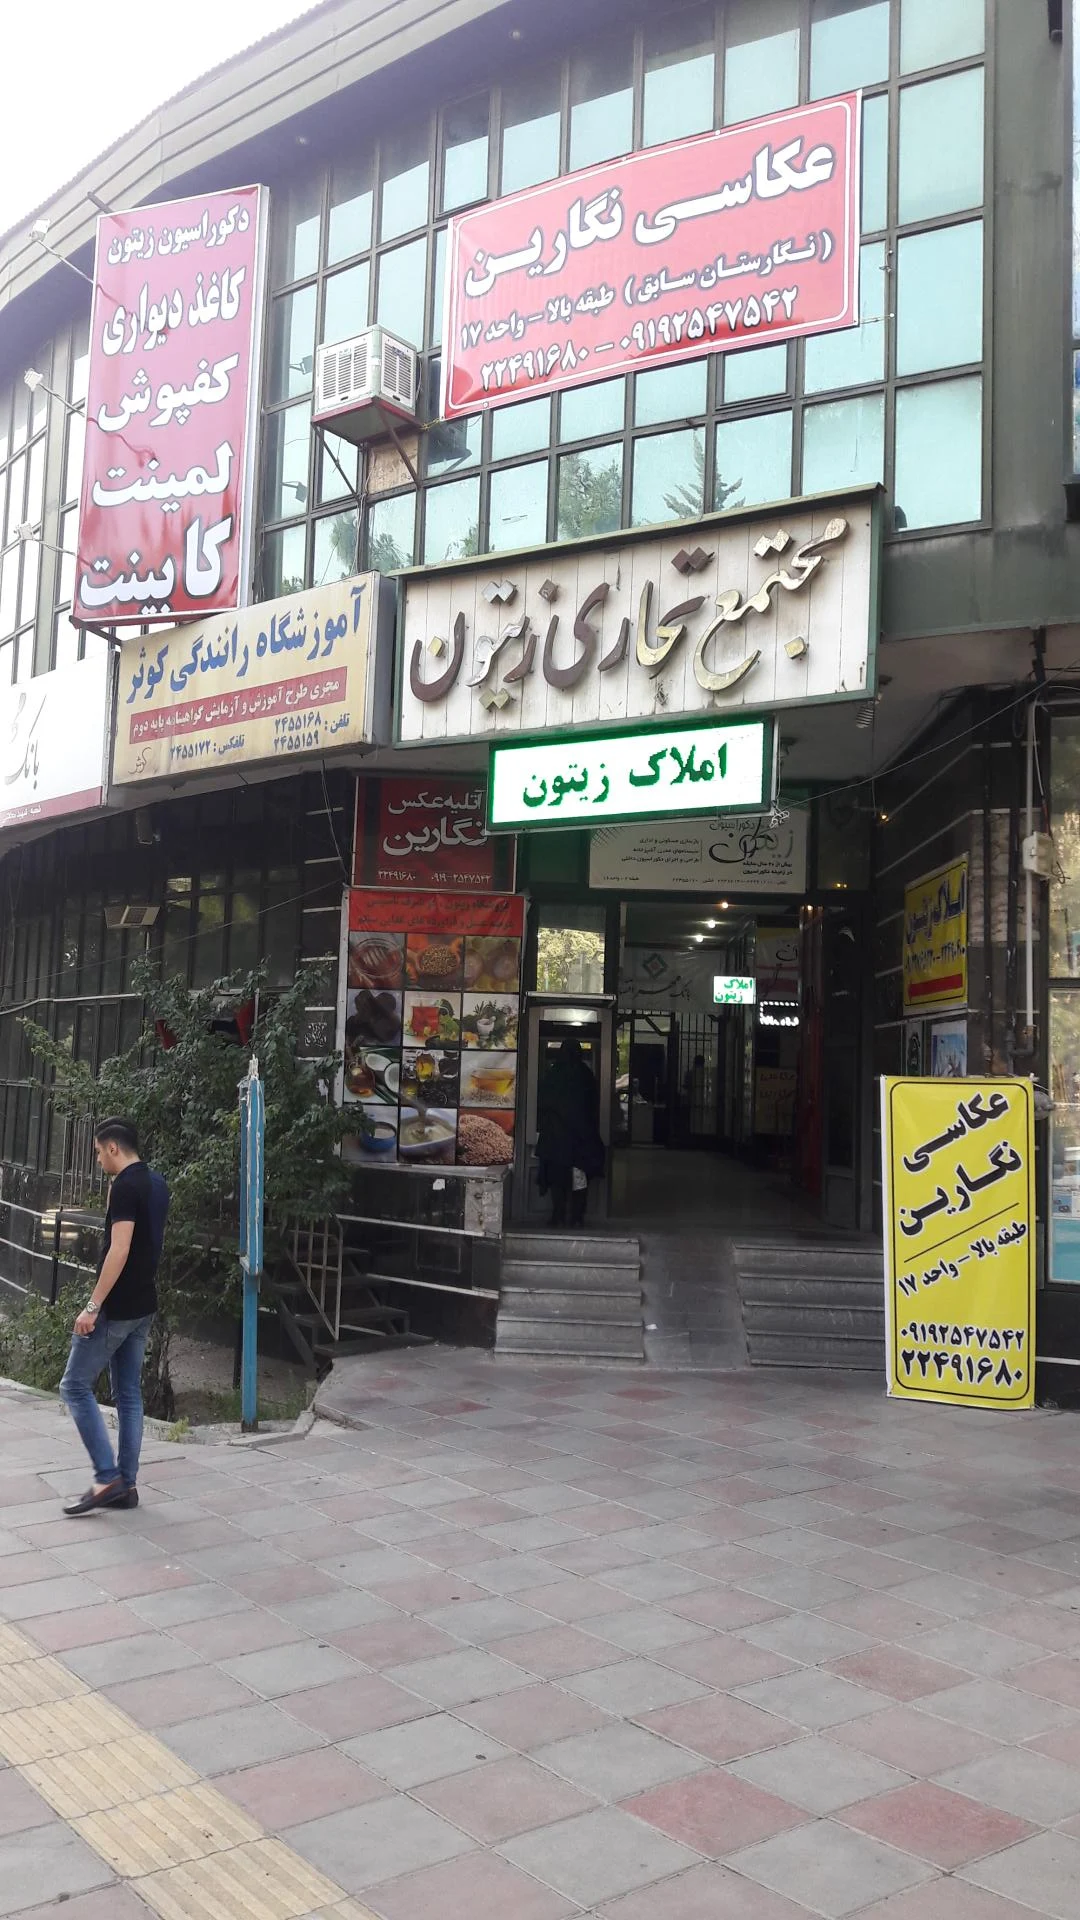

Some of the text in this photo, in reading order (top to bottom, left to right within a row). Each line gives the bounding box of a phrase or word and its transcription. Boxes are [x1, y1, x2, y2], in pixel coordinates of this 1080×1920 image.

[464, 138, 835, 296] عکاسی نگارین
[107, 204, 250, 265] دکوراسیون زیتون
[101, 266, 247, 356] کاغذ دیواری
[547, 298, 572, 325] بالا
[576, 287, 615, 315] طبقه
[486, 311, 525, 342] واحد
[620, 285, 799, 351] ۰۹۱۹۲۵۴۷۵۴۲
[461, 322, 482, 350] ۱۷
[481, 339, 588, 391] ۲۲۴۹۱۶۸۰
[98, 353, 240, 433] کفپوش
[91, 440, 235, 512] لمینت
[79, 514, 233, 615] کابینت
[693, 517, 849, 691] مجتمع
[126, 583, 366, 704] آموزشگاه رانندگی کوثر
[410, 579, 558, 711] زیتون
[249, 686, 283, 714] آموزش
[285, 683, 308, 705] طرح
[309, 680, 339, 699] مجری
[206, 695, 240, 722] آزمایش
[242, 702, 248, 715] و
[274, 711, 322, 735] ۲۴۵۵۱۶۸
[132, 720, 149, 737] دوم
[150, 715, 165, 732] پایه
[273, 731, 319, 751] ۲۴۵۵۱۵۹
[522, 743, 728, 807] املاک زیتون
[388, 789, 486, 814] آتلیه عکس
[383, 816, 488, 856] نگارین
[715, 991, 743, 1003] زیتون
[724, 978, 753, 989] املاک
[903, 1092, 1010, 1172] عکاسی
[900, 1140, 1022, 1236] نگارین
[970, 1237, 995, 1260] بالا
[997, 1221, 1028, 1247] طبقه
[898, 1273, 917, 1297] ۱۷
[922, 1259, 959, 1288] واحد
[901, 1321, 1025, 1350] ۰۹۱۹۲۵۴۷۵۴۲
[901, 1349, 1023, 1387] ۲۲۴۹۱۶۸۰
